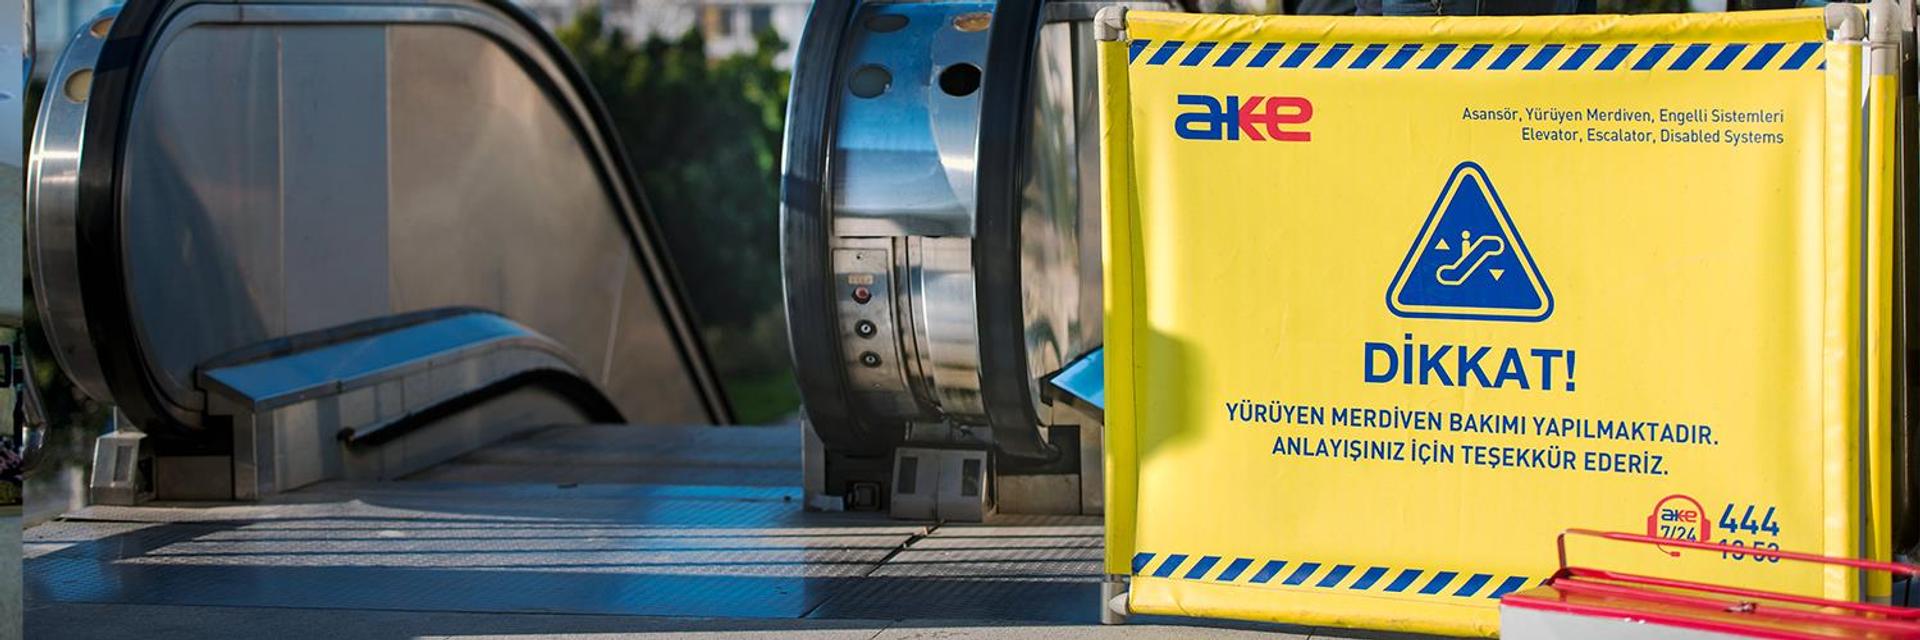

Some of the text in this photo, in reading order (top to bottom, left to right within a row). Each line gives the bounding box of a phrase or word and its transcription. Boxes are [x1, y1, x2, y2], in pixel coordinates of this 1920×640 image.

[1174, 94, 1314, 142] ake
[1462, 107, 1784, 126] Asansör, Yürüyen Merdiven, Engelli Sistemleri
[1521, 126, 1784, 147] Elevator, Escalator, Disabled Systems
[1364, 332, 1576, 392] DİKKAT!
[1225, 399, 1718, 445] YÜRÜYEN MERDİVEN BAKIMI YAPILMAKTADIR.
[1272, 436, 1669, 476] ANLAYIŞINIZ İÇİN TEŞEKKÜR EDERİZ.
[1660, 508, 1697, 523] ake
[1718, 503, 1780, 536] 444
[1660, 525, 1696, 542] 7/24
